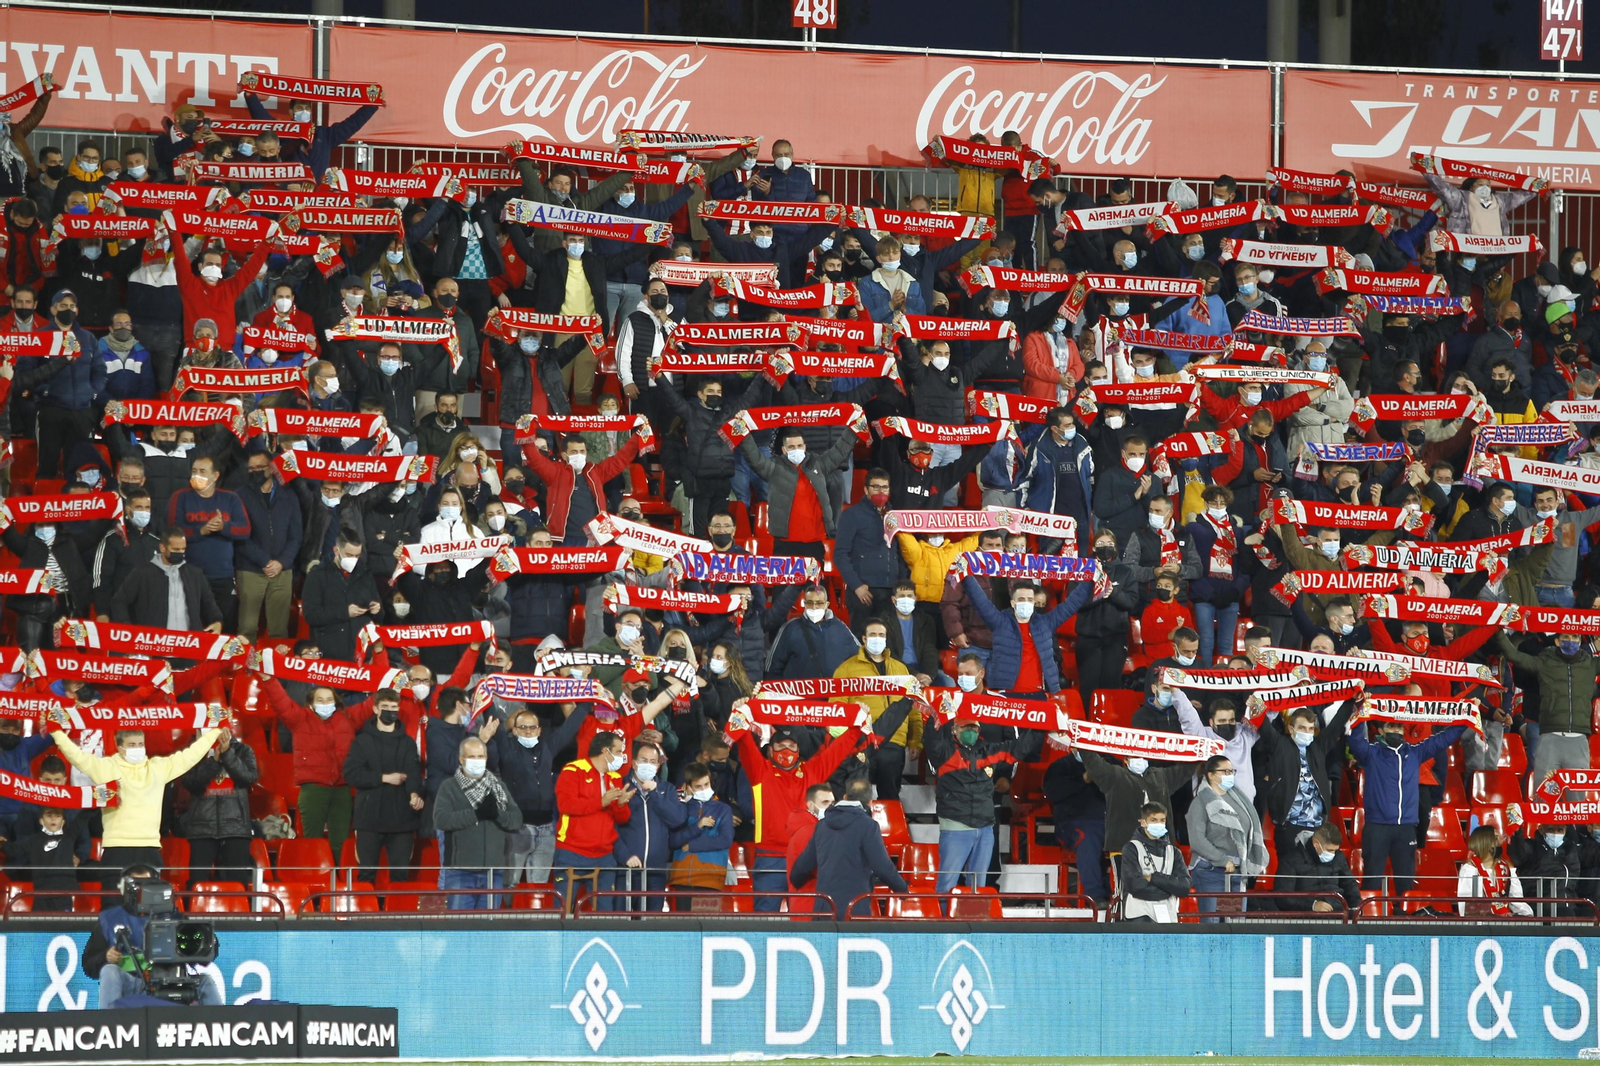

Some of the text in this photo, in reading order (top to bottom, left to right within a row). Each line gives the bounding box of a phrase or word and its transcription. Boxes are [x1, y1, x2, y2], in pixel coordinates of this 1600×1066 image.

[794, 0, 829, 24] 48
[1544, 28, 1575, 56] 47
[262, 78, 362, 98] U.D.ALMERÍA
[443, 43, 708, 143] Coca-Cola
[1405, 83, 1598, 103] TRANSPORTE
[916, 66, 1168, 165] Coca-Cola
[646, 133, 666, 143] UD
[530, 143, 628, 165] U.D.ALMERÍA
[953, 144, 1020, 161] UD ALMERÍA
[1451, 163, 1467, 172] UD
[355, 176, 426, 189] UD ALMERÍA
[1276, 171, 1342, 187] UD ALMERÍA
[120, 188, 197, 200] UD ALMERÍA
[1361, 183, 1427, 202] UD ALMERÍA
[253, 195, 351, 207] U.D.ALMERÍA
[533, 206, 613, 225] ALMERIA
[722, 203, 820, 218] U.D.ALMERÍA
[1182, 206, 1247, 225] UD ALMERÍA
[1291, 207, 1358, 219] UD ALMERÍA
[71, 218, 149, 231] UD ALMERÍA
[183, 213, 258, 231] UD ALMERÍA
[303, 212, 398, 228] U.D.ALMERÍA
[884, 215, 955, 229] UD ALMERÍA
[552, 223, 629, 239] ORGULLO ROJIBLANCO
[1001, 271, 1018, 281] UD
[1354, 275, 1420, 287] UD ALMERÍA
[749, 286, 815, 300] UD ALMERÍA
[1088, 277, 1197, 294] U.D. ALMERIA
[365, 319, 385, 332] UD
[675, 327, 781, 339] U.D.ALMERÍA
[919, 320, 990, 331] UD ALMERÍA
[848, 330, 864, 340] UD
[802, 355, 874, 368] UD ALMERÍA
[189, 371, 300, 385] U.D.ALMERÍA
[1238, 370, 1278, 378] QUIERO
[1280, 370, 1316, 379] UNIÓN!
[1105, 384, 1182, 396] UD ALMERÍA
[1018, 403, 1036, 413] UD
[1381, 398, 1457, 410] UD ALMERÍA
[129, 403, 233, 421] UD ALMERIA
[762, 411, 779, 421] UD
[286, 414, 361, 428] UD ALMERÍA
[917, 423, 934, 433] UD
[1171, 441, 1187, 452] UD
[306, 458, 388, 472] UD ALMERÍA
[19, 498, 105, 513] UD ALMERÍA
[903, 512, 989, 528] UD ALMERIA
[1315, 507, 1387, 521] UD ALMERÍA
[529, 552, 607, 564] UD ALMERÍA
[1376, 549, 1474, 569] UD ALMERIA
[708, 573, 806, 584] ORGULLO ROJIBLANCO
[1301, 573, 1399, 588] UD ALMERIA
[638, 588, 657, 599] UD
[1407, 601, 1482, 616] UD ALMERÍA
[1538, 613, 1559, 623] UD
[110, 629, 199, 648] UD ALMERÍA
[386, 625, 471, 642] UD ALMERÍA
[57, 658, 148, 676] UD ALMERÍA
[1281, 653, 1305, 669] UD
[284, 658, 371, 681] UD ALMERÍA
[763, 677, 900, 697] SOMOS DE PRIMERA
[92, 707, 183, 720] UD ALMERÍA
[761, 704, 845, 717] UD ALMERÍA
[970, 703, 1046, 722] UD ALMERÍA
[1377, 700, 1401, 713] UD
[14, 777, 71, 798] ALMERÍA
[1530, 803, 1550, 814] UD
[37, 935, 87, 1010] &
[700, 937, 893, 1046] PDR
[1265, 936, 1600, 1041] Hotel & S
[0, 1024, 140, 1053] #FANCAM
[156, 1021, 294, 1047] #FANCAM
[306, 1021, 395, 1047] #FANCAM
